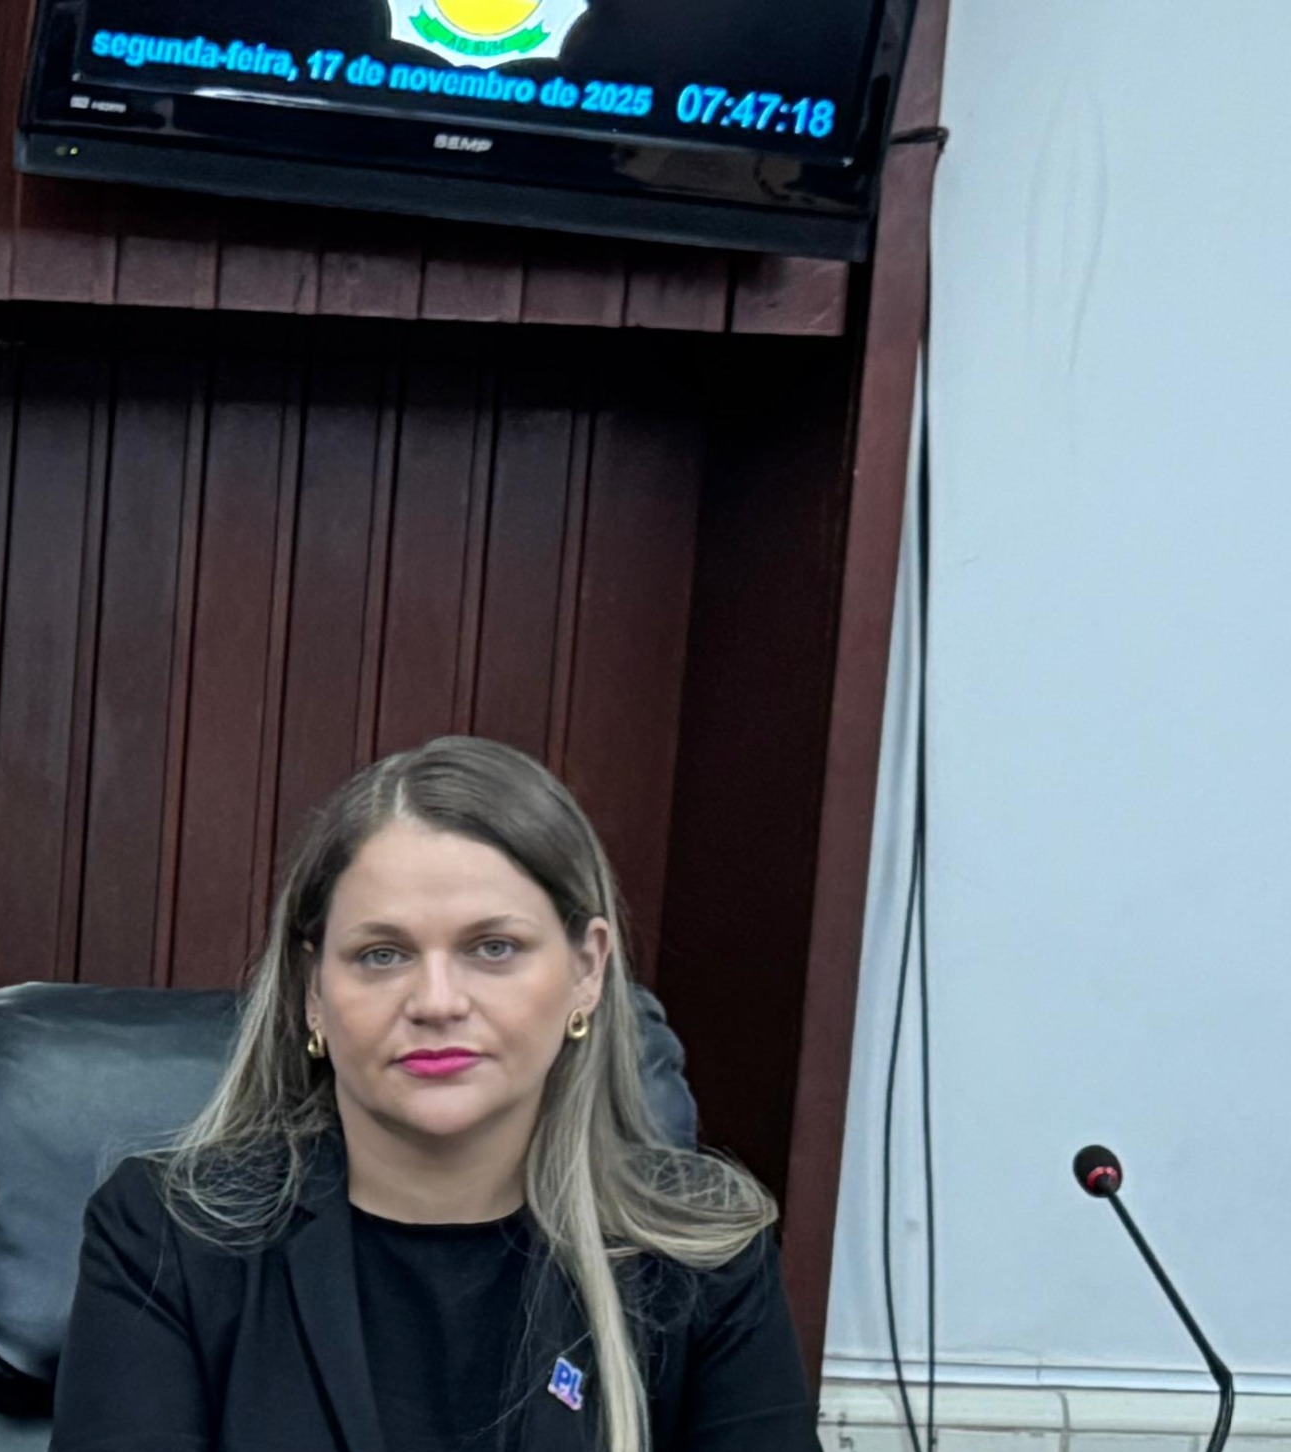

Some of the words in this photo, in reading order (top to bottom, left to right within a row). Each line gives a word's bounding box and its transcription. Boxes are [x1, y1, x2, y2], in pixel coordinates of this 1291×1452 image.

[91, 29, 298, 82] segunda-feira,
[307, 49, 344, 81] 17
[346, 54, 386, 87] de
[389, 63, 536, 103] novembro
[539, 77, 580, 108] de
[581, 80, 653, 116] 2025
[677, 84, 835, 137] 07:47:18
[433, 133, 493, 153] SEMP
